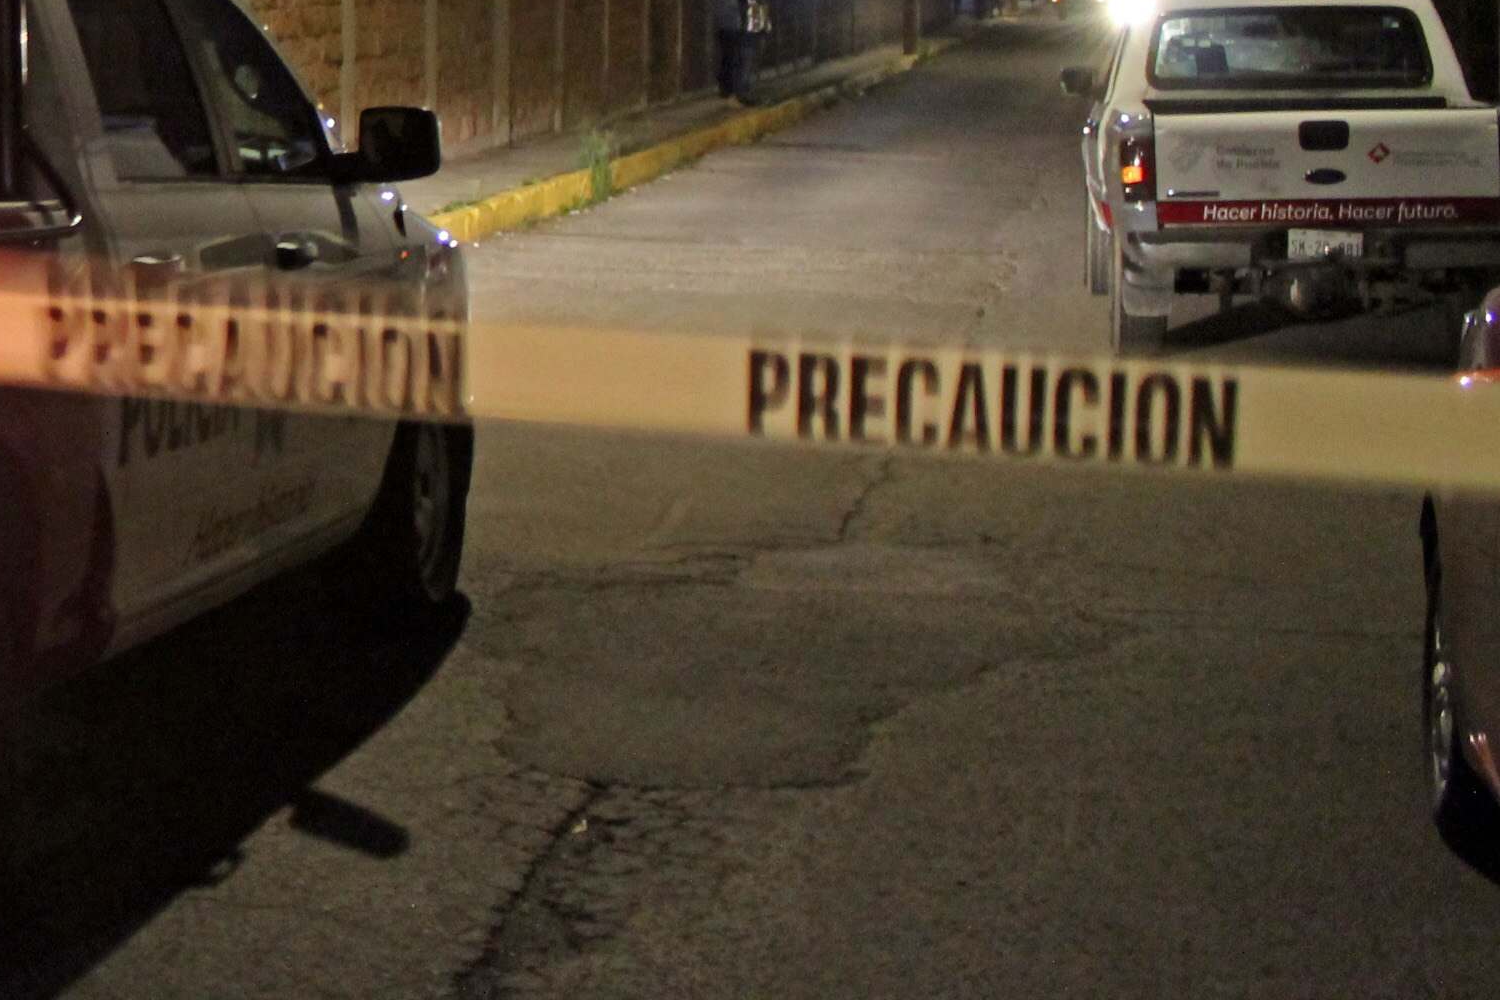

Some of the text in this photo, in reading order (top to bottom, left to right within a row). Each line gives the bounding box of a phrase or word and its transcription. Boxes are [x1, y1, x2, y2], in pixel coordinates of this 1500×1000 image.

[1202, 202, 1459, 224] Hacer historia. Hacer futuro.
[748, 348, 1240, 470] PRECAUCION
